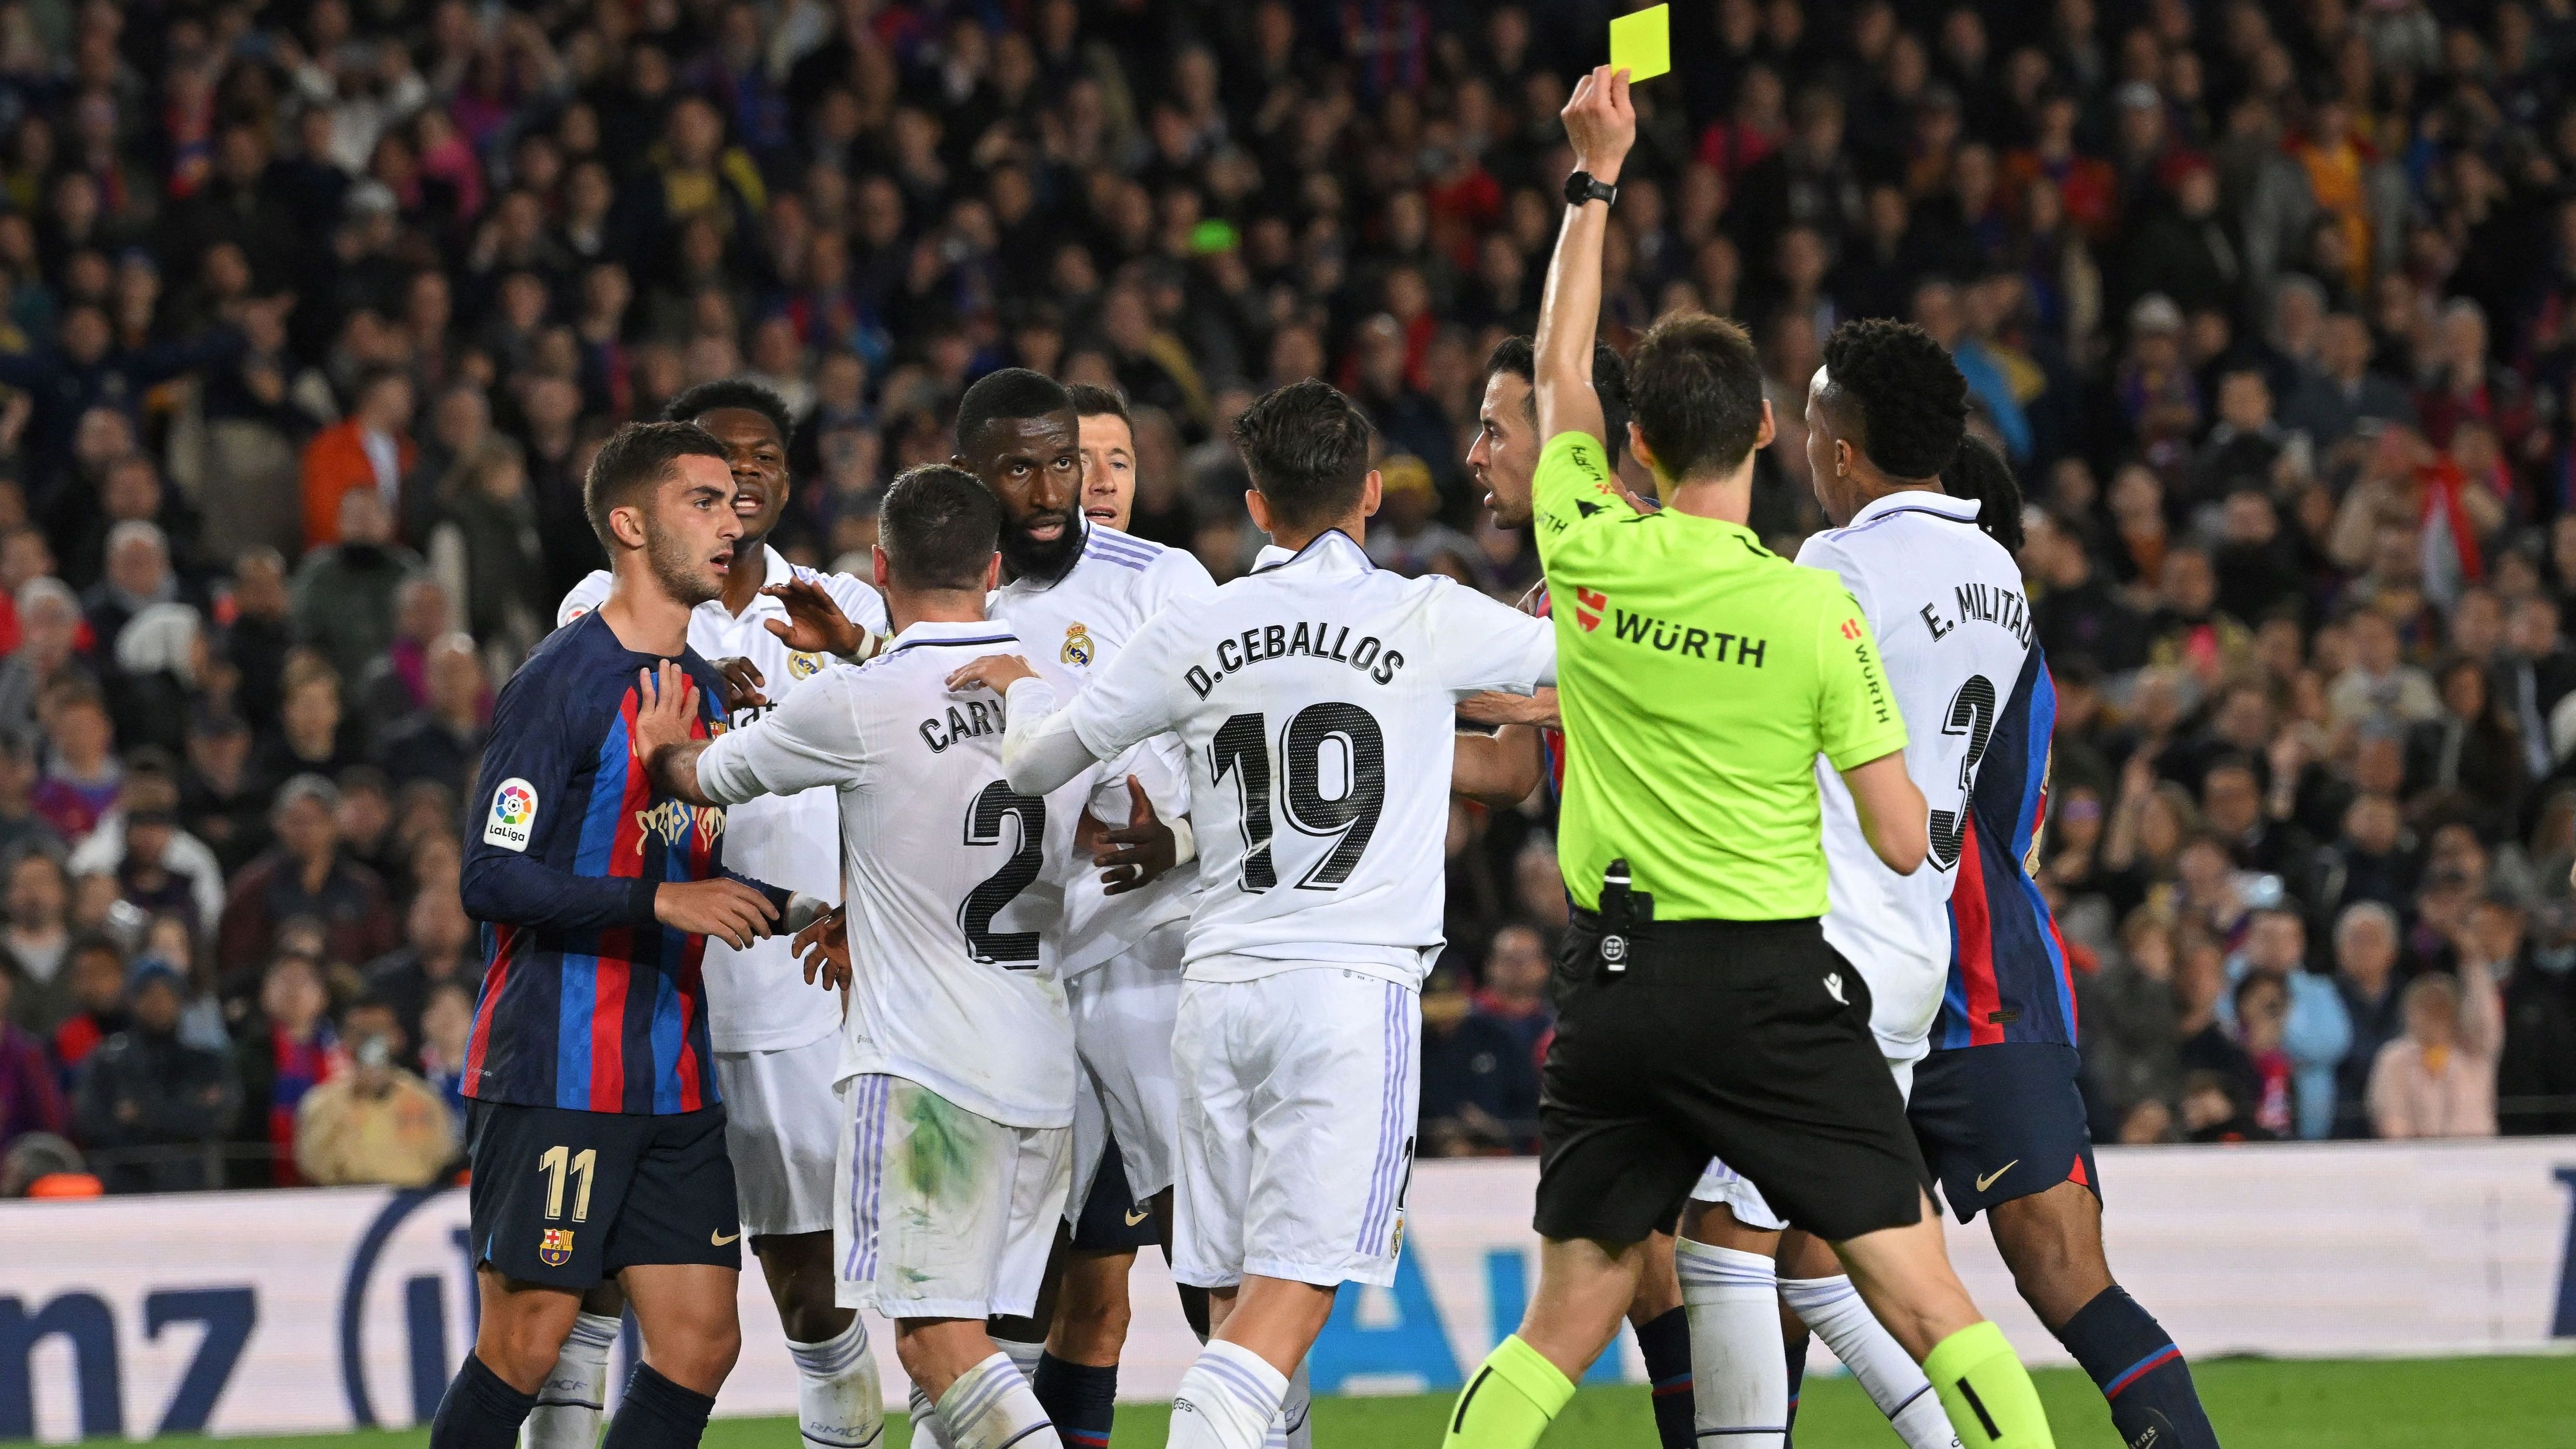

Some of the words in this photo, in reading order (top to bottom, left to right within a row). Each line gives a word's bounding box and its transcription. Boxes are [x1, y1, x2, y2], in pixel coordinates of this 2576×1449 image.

[1920, 602, 1954, 643] E.
[919, 699, 1007, 754] CARV
[1206, 701, 1386, 895] 19
[1926, 674, 1996, 874] 3
[489, 824, 525, 842] LaLiga
[956, 779, 1046, 971] 2
[538, 1145, 597, 1223] 11
[1396, 1135, 1414, 1213] 1
[1173, 1398, 1193, 1412] das
